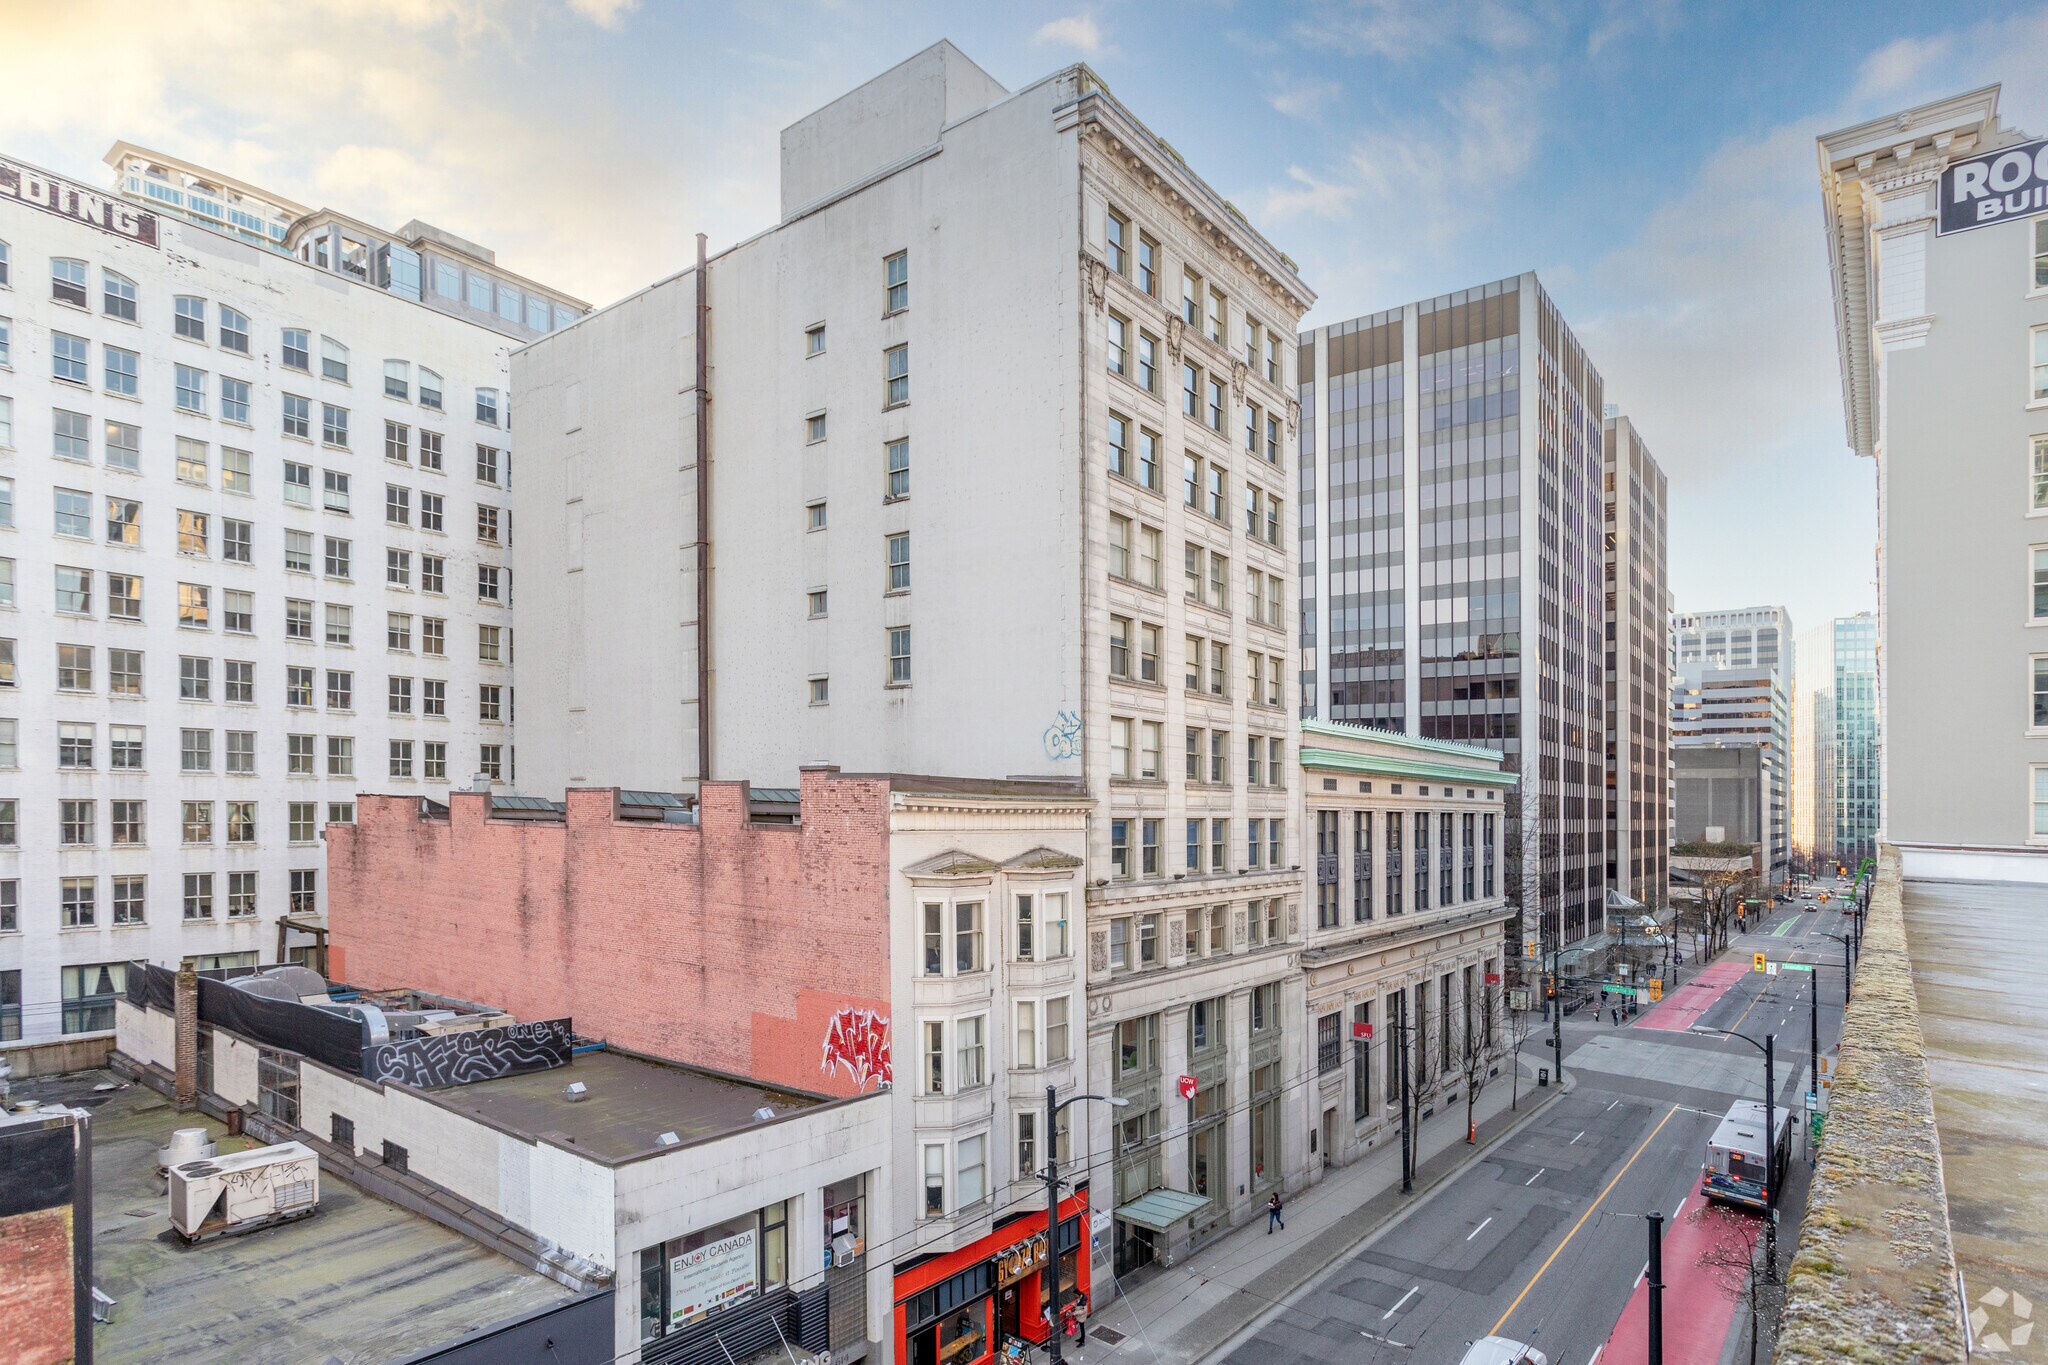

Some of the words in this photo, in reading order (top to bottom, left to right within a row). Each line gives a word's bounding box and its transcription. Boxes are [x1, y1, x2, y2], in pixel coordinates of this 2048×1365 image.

[0, 164, 139, 237] DING
[1976, 185, 2048, 222] BUI
[1180, 1076, 1194, 1085] UCW
[674, 1250, 707, 1271] ENJOY
[709, 1234, 752, 1257] CANADA
